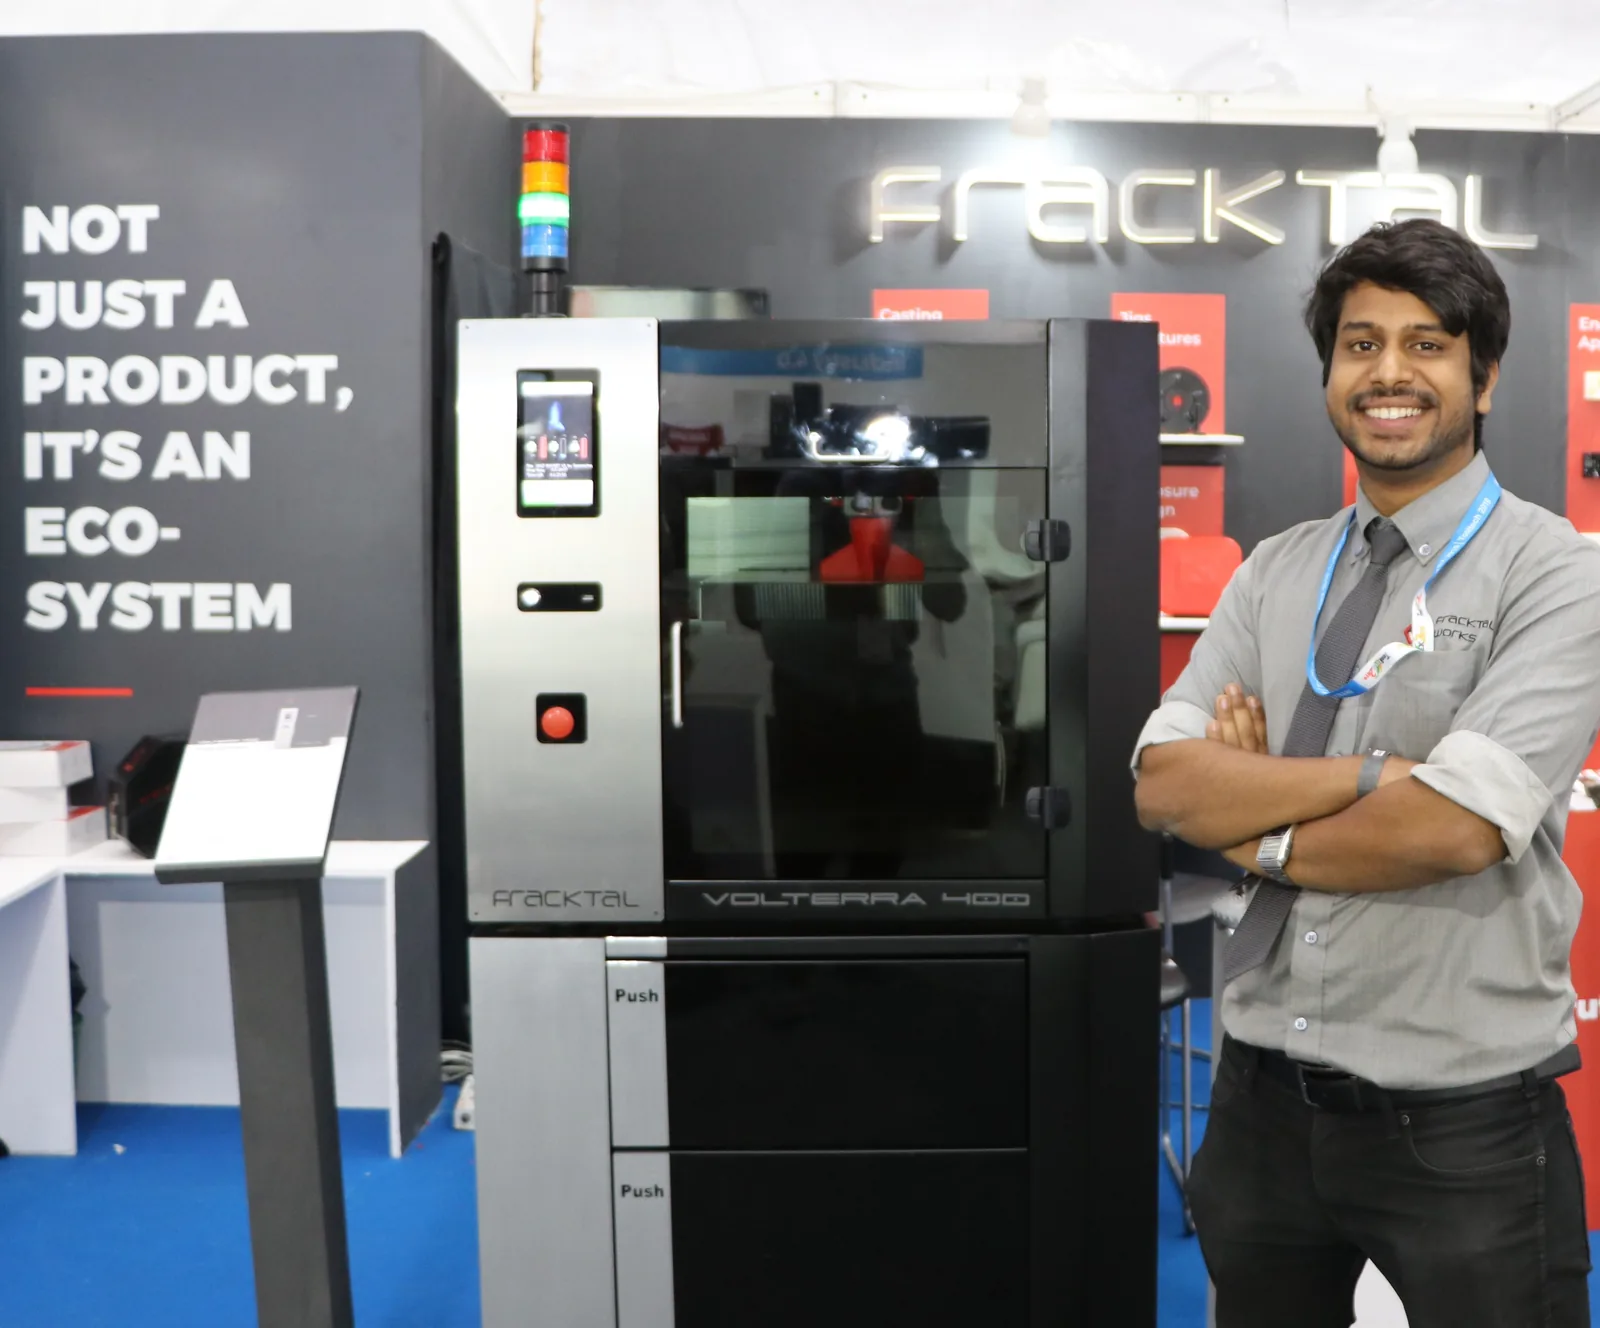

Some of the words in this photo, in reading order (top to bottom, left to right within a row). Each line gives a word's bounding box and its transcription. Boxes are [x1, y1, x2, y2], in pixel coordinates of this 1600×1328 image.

[23, 203, 160, 255] NOT
[21, 278, 187, 330] JUST
[195, 279, 249, 328] A
[1158, 331, 1202, 346] tures
[23, 353, 354, 412] PRODUCT,
[23, 428, 143, 481] IT’S
[151, 431, 251, 480] AN
[25, 505, 181, 557] ECO-
[25, 580, 293, 632] SYSTEM
[702, 892, 928, 907] VOLTERRA
[941, 892, 1031, 907] 400
[615, 988, 659, 1003] Push
[621, 1184, 665, 1198] Push
